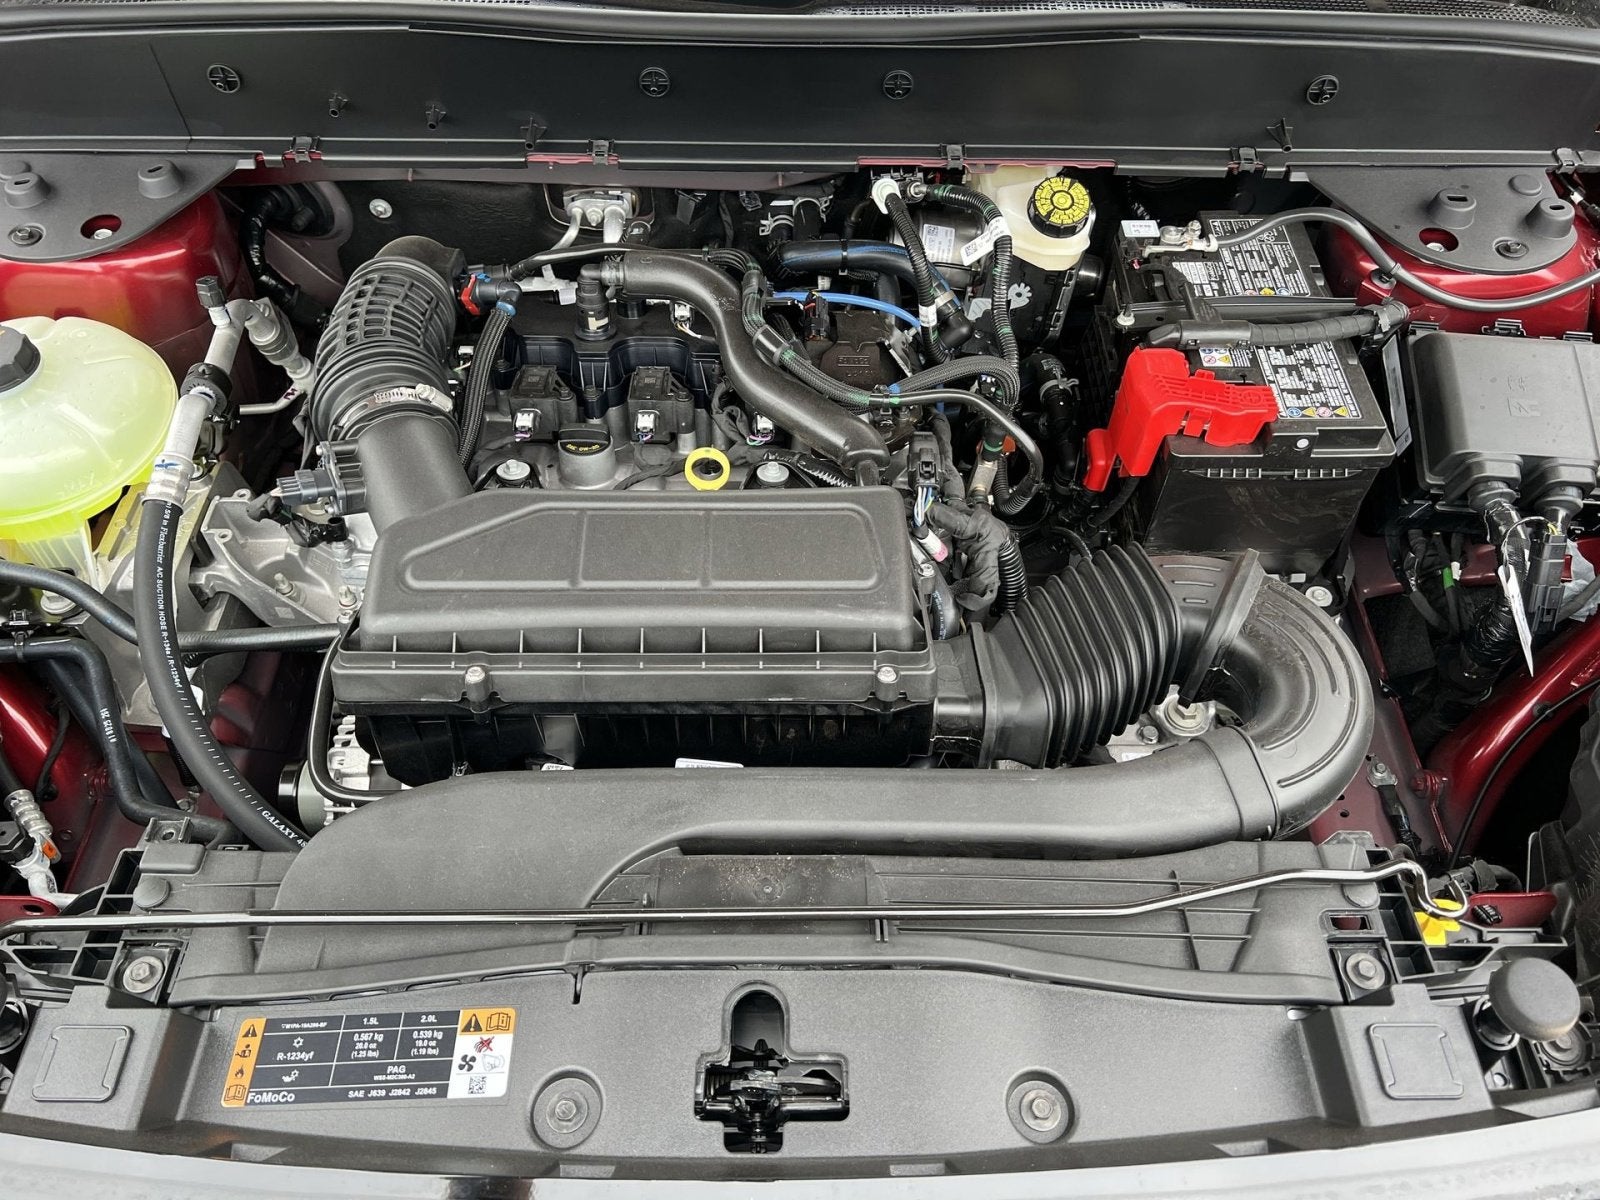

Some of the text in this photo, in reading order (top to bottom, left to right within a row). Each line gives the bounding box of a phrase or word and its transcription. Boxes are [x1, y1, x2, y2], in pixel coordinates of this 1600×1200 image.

[156, 526, 169, 564] Flexbarrier
[156, 566, 164, 578] A/C
[156, 579, 165, 610] SUCTION
[158, 611, 168, 631] HOSE
[161, 631, 172, 655] R-134a
[168, 659, 183, 688] R-1234yf
[261, 810, 298, 839] GALAXY
[363, 1017, 379, 1025] 1.5L
[420, 1015, 437, 1023] 2.0L
[353, 1033, 384, 1042] 0.567 kg
[412, 1030, 443, 1039] 0.539 kg
[276, 1051, 314, 1062] R-1234yf
[367, 1050, 379, 1058] lbs)
[427, 1047, 439, 1055] lbs)
[387, 1065, 406, 1074] PAG
[246, 1091, 296, 1104] FoMoCo
[348, 1087, 437, 1098] SAE J639 J2842 J2845
